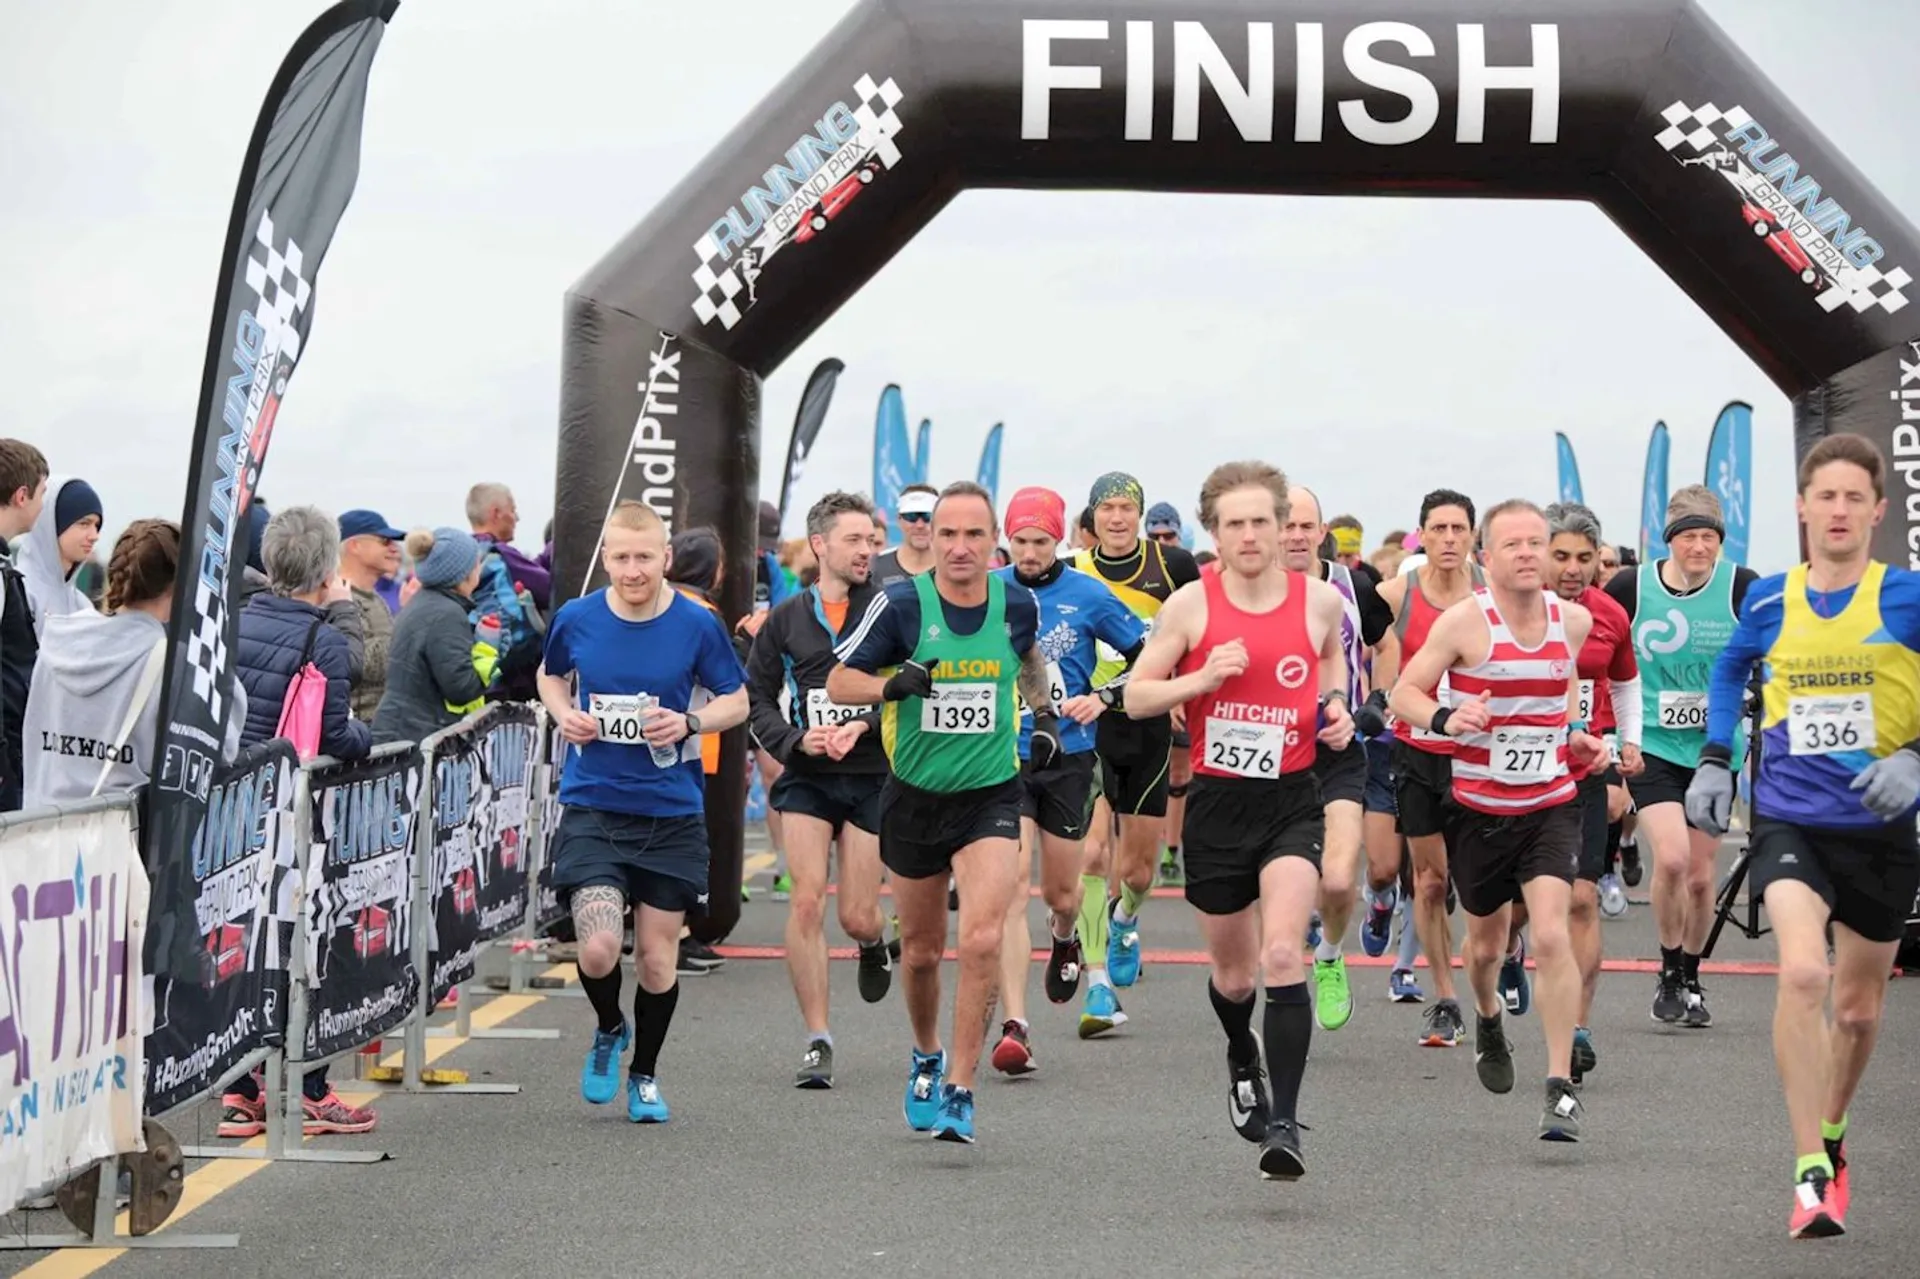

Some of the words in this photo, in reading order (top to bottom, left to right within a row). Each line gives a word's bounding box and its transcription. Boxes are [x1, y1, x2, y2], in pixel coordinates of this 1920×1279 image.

[1021, 19, 1560, 145] FINISH
[708, 101, 861, 261] RUNNING
[773, 176, 829, 233] GRAND
[827, 137, 866, 178] PRIX
[1725, 120, 1885, 268] RUNNING
[1752, 183, 1812, 238] GRAND
[1810, 239, 1846, 275] PRIX
[250, 352, 274, 408] PRIX
[201, 310, 265, 597] RUNNING
[1806, 653, 1874, 670] ALBANS
[1788, 671, 1875, 690] STRIDERS
[598, 716, 645, 740] 140
[932, 706, 990, 729] 1393
[1213, 701, 1298, 726] HITCHIN
[1805, 721, 1859, 749] 336
[1211, 742, 1274, 773] 2576
[1504, 748, 1546, 771] 277
